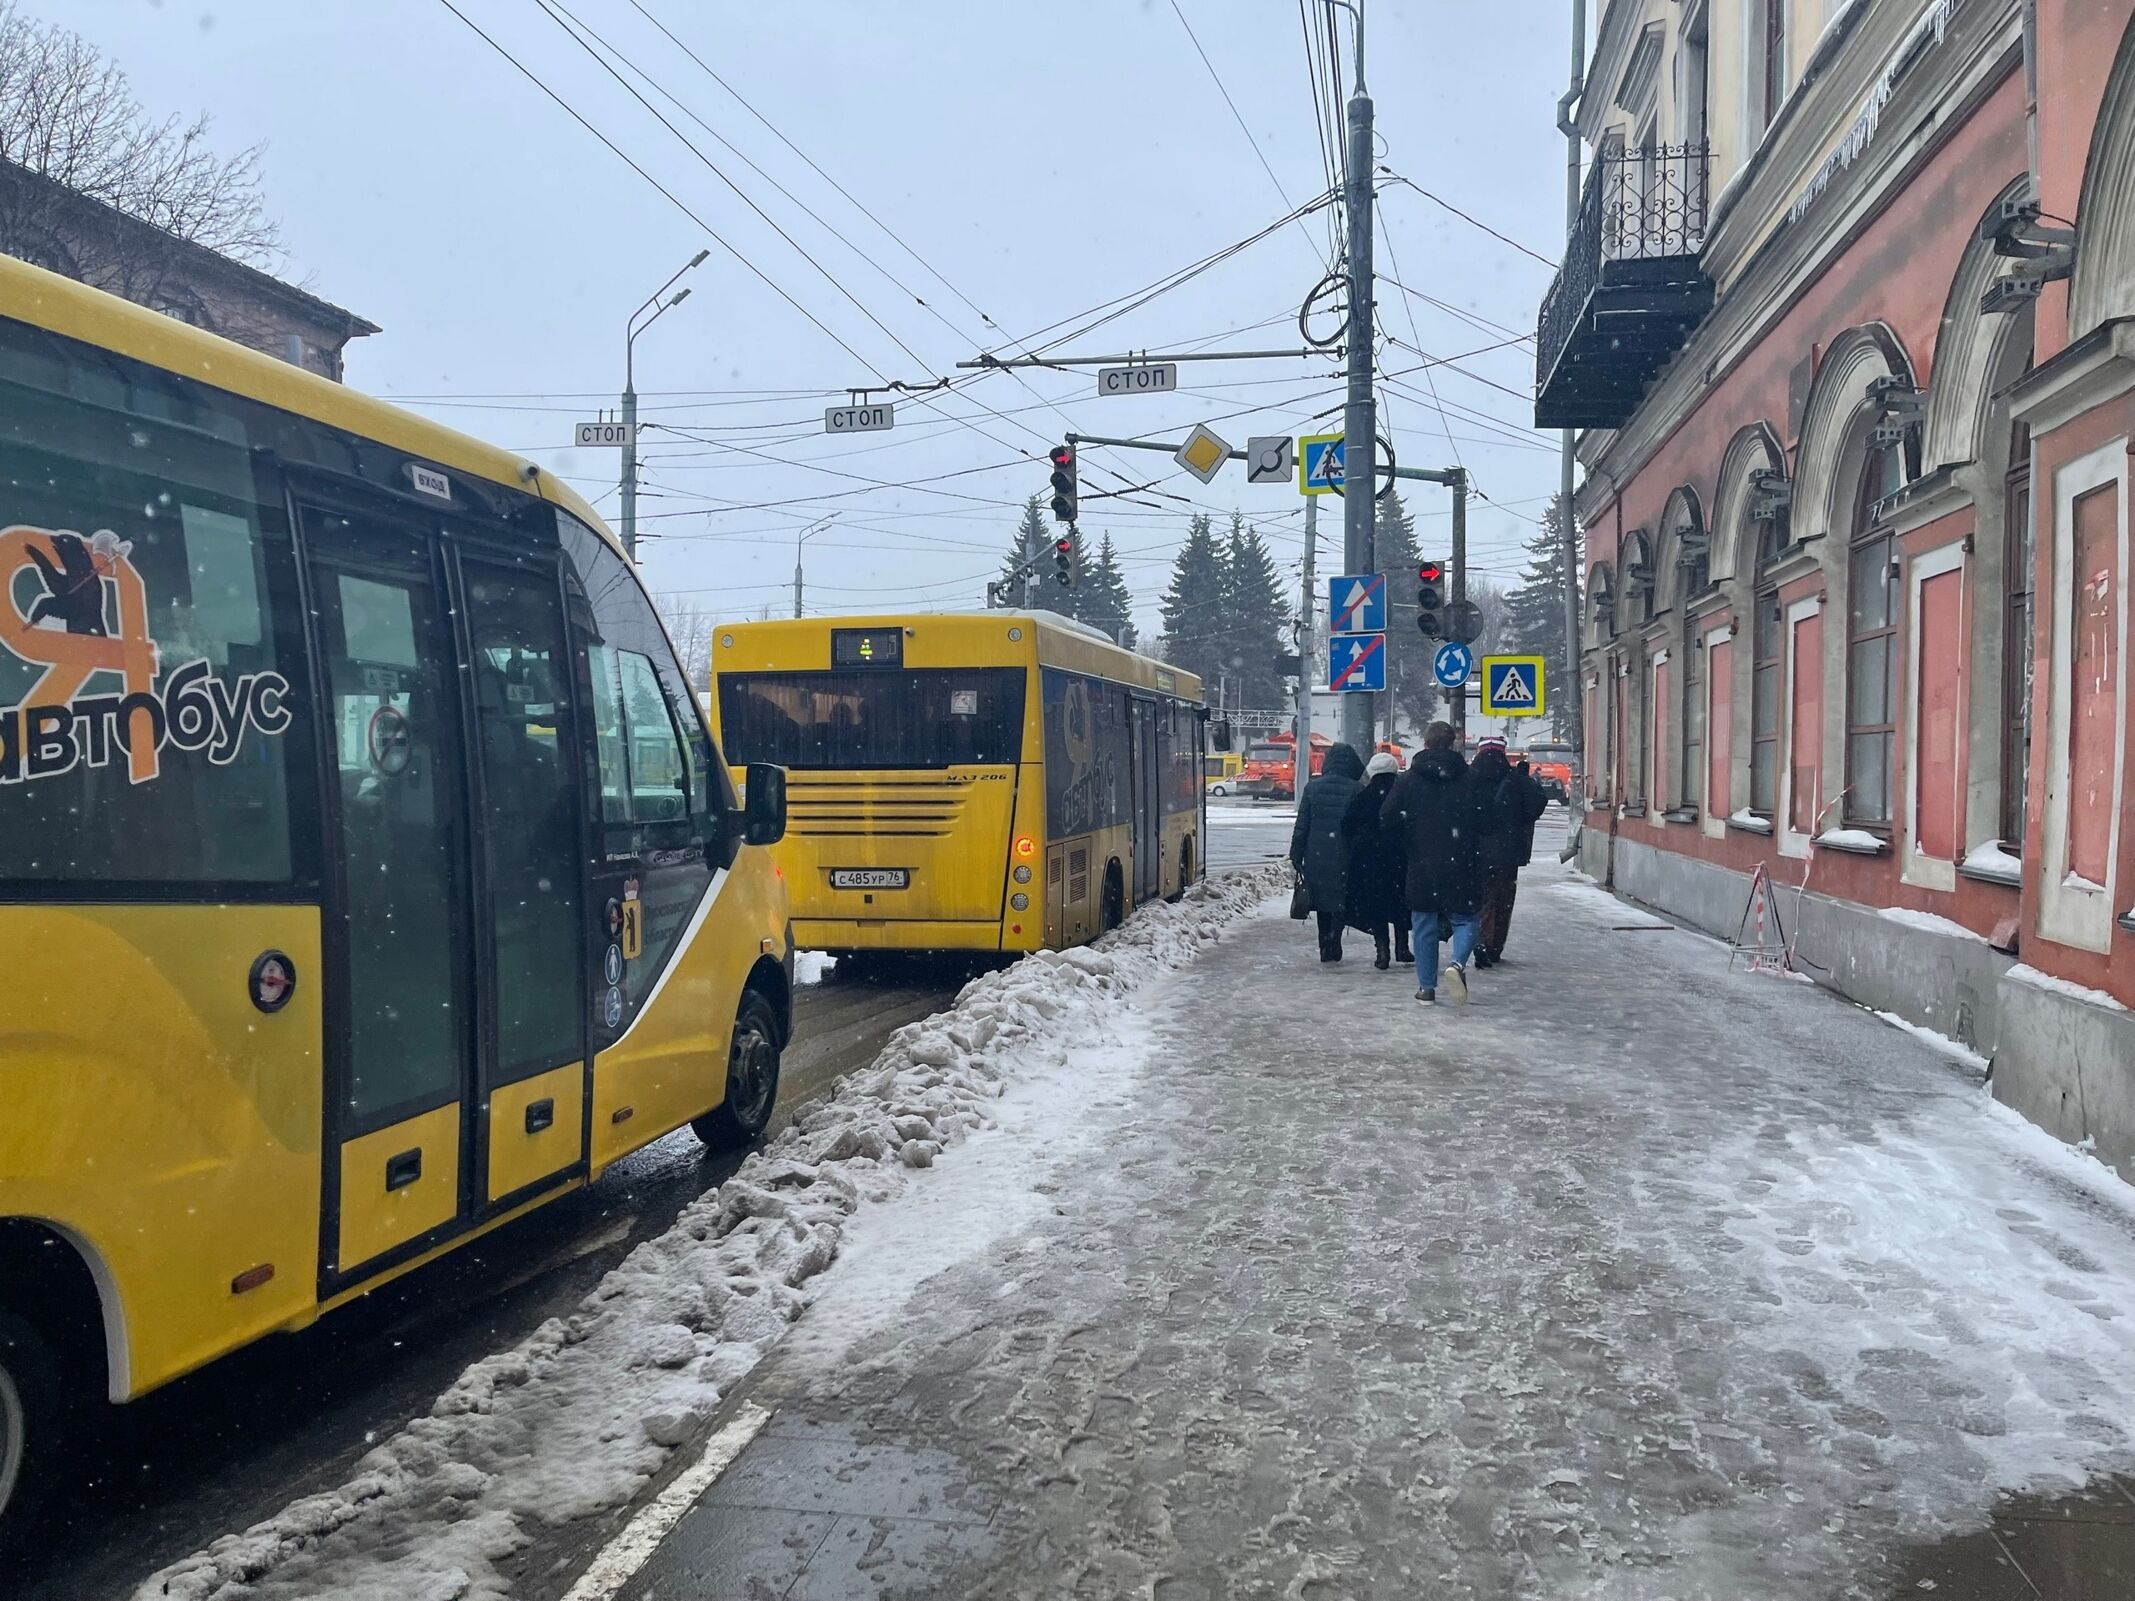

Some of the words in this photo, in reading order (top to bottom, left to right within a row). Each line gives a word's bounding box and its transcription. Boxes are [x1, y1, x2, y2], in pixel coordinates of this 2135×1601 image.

[1107, 368, 1165, 390] СТОП
[833, 409, 884, 428] СТОП
[582, 426, 626, 442] СТОП
[418, 473, 446, 495] ВХОД
[888, 871, 900, 881] 76
